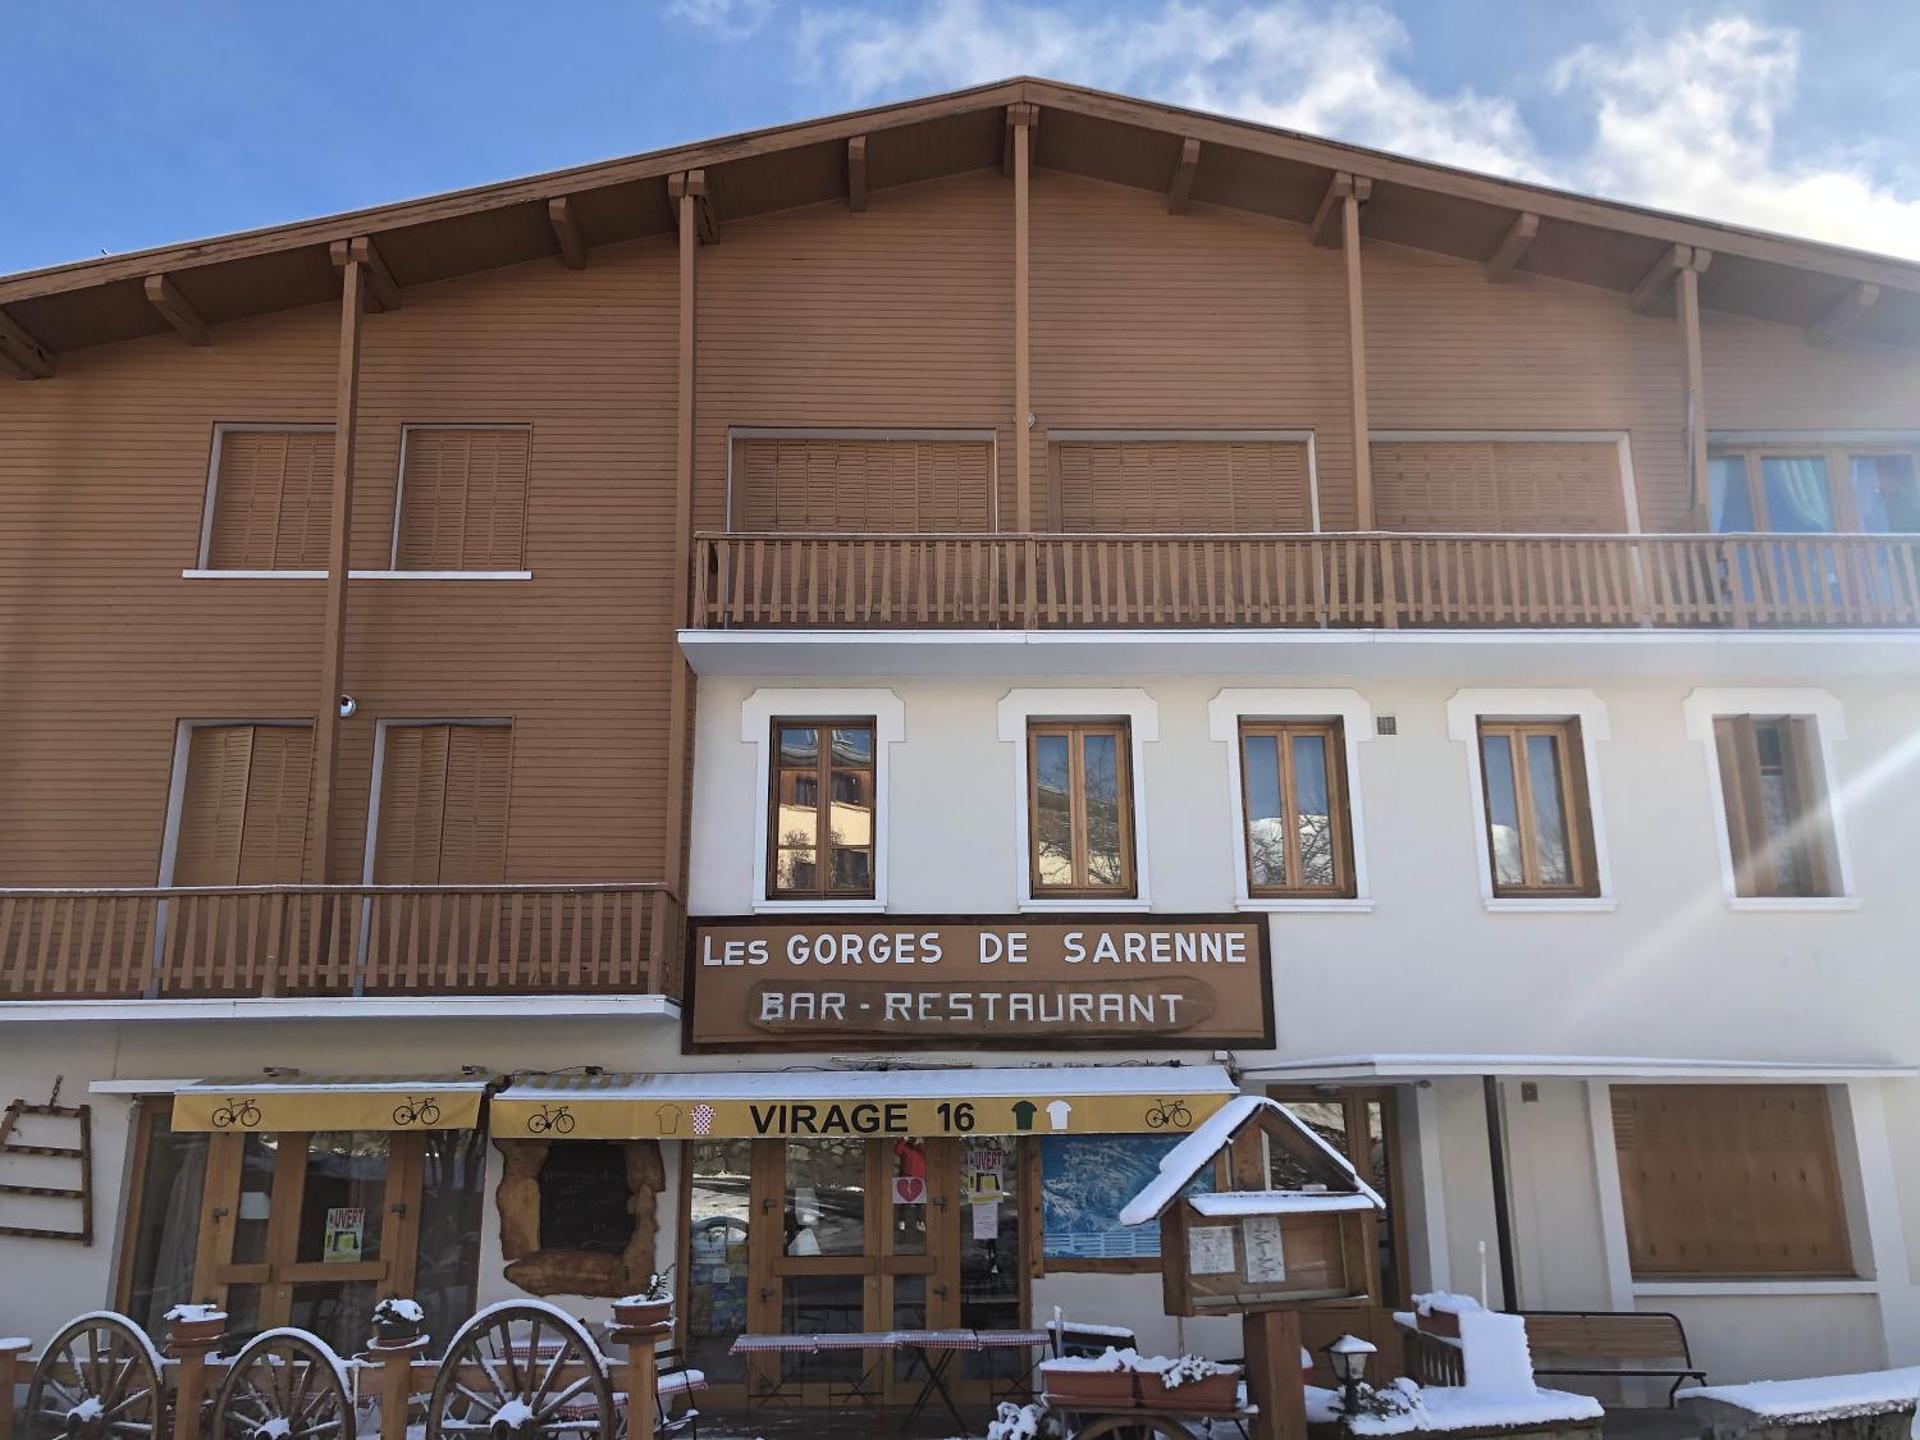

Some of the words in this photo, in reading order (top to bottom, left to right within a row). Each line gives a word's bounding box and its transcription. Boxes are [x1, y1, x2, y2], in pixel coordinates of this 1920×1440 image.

[703, 935, 769, 966] LES
[786, 932, 943, 965] GORGES
[979, 932, 1028, 964] DE
[1063, 932, 1246, 964] SARENNE
[760, 992, 846, 1021] BAR
[883, 992, 1183, 1023] RESTAURANT
[750, 1103, 908, 1134] VIRAGE
[937, 1102, 975, 1132] 16
[969, 1151, 1002, 1170] UVERT
[329, 1208, 364, 1229] UVERT
